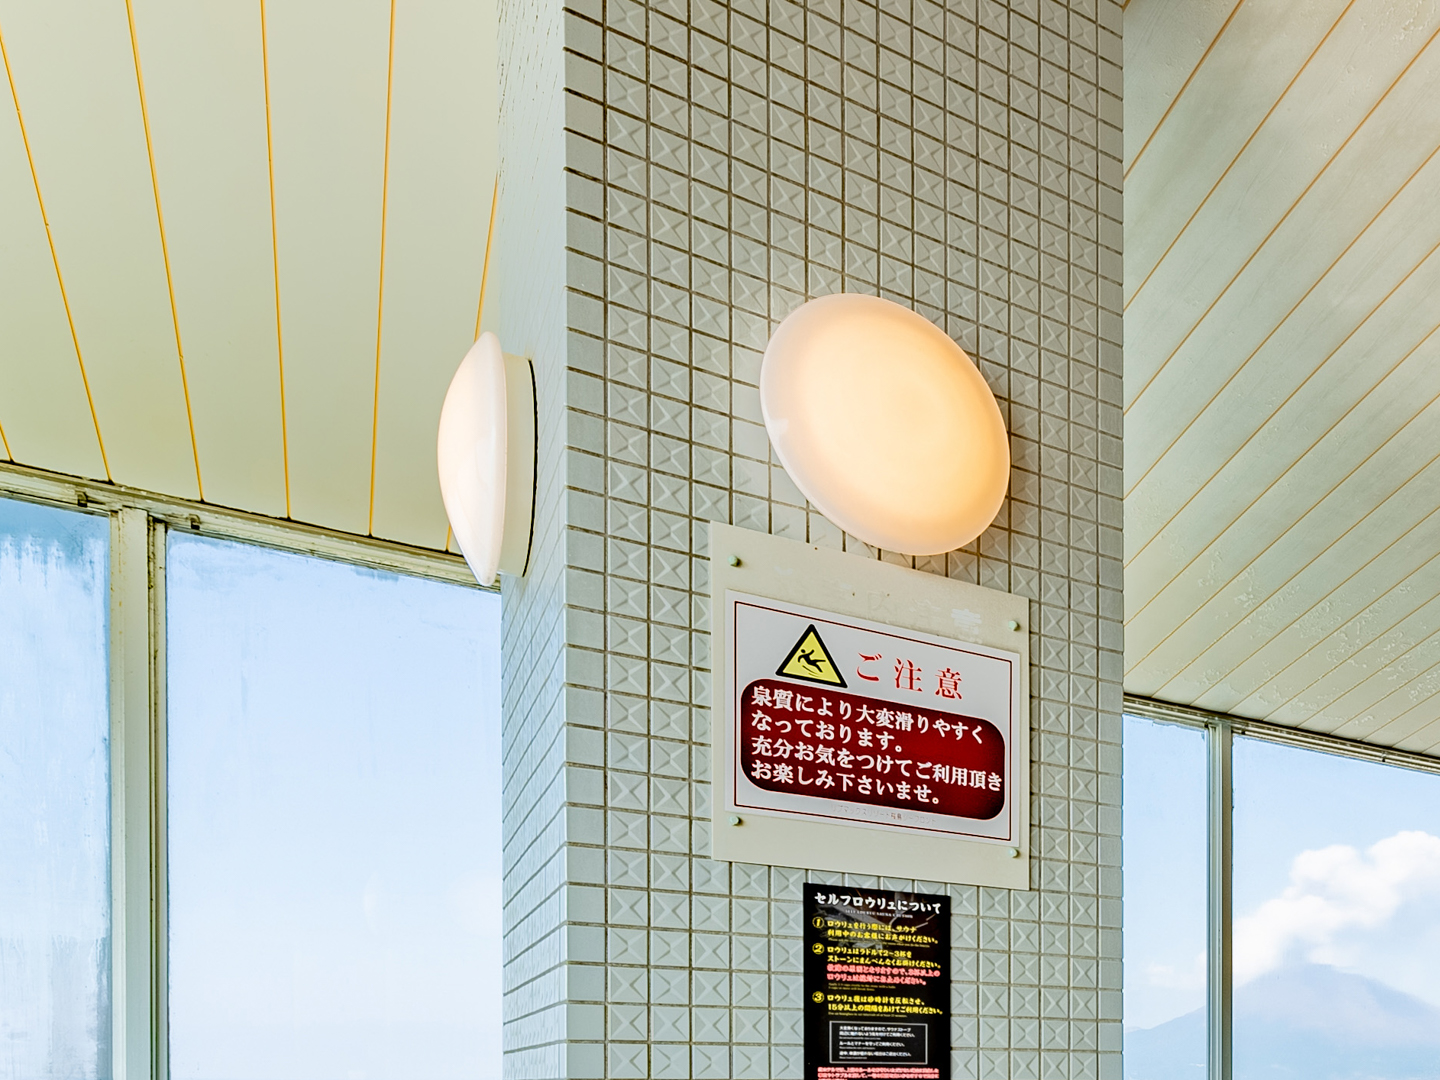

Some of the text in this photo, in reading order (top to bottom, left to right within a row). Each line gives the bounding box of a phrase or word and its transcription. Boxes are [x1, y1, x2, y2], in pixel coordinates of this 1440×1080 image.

[856, 652, 963, 700] ご注意
[751, 685, 983, 745] 泉質により大変滑りやすく
[751, 710, 902, 752] なっております。
[751, 735, 1003, 792] 充分お気をつけてご利用頂き
[751, 759, 940, 804] お楽しみ下さいませ。
[814, 892, 941, 915] セルフロウリュについて
